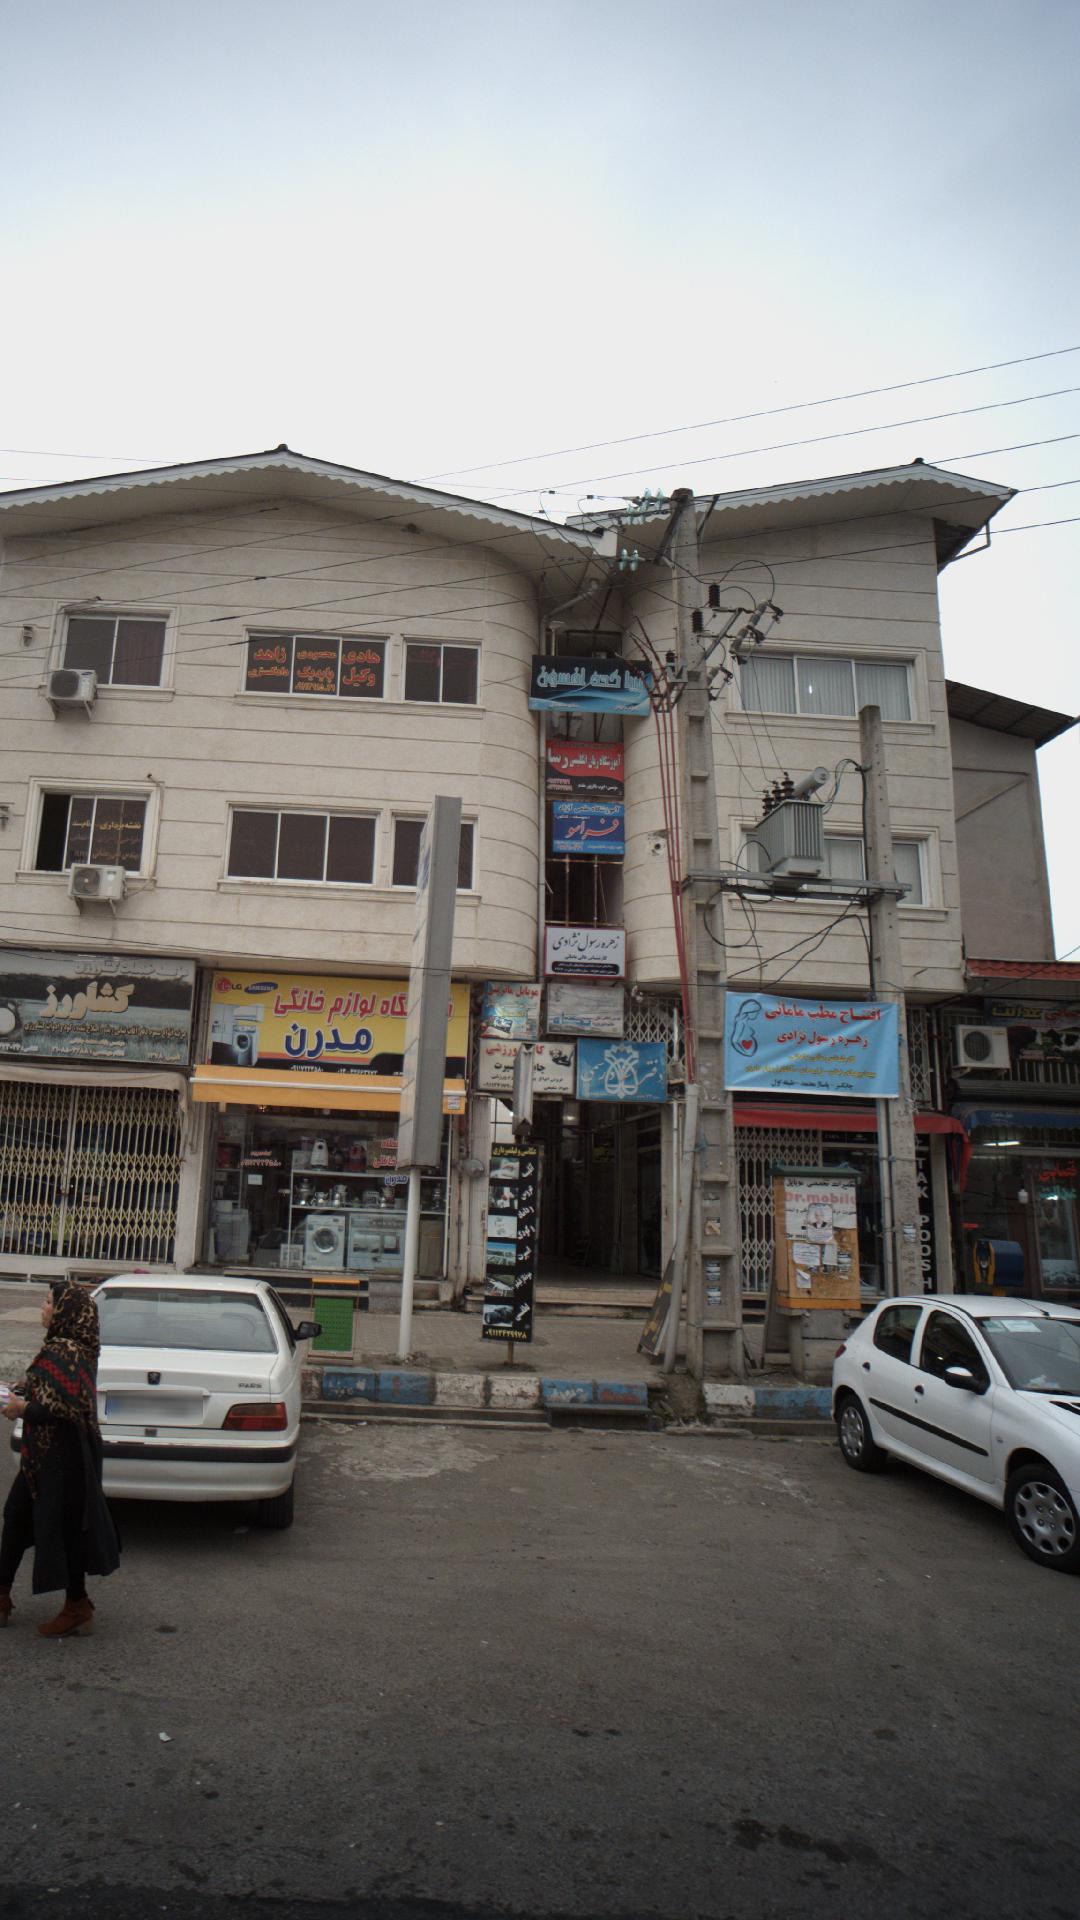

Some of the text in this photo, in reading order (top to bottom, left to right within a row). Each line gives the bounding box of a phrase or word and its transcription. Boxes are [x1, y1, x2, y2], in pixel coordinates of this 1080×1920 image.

[39, 982, 136, 1020] کشاورز
[231, 983, 243, 991] LG
[273, 985, 325, 1018] خانگی
[327, 990, 377, 1026] لوازم
[839, 1007, 881, 1024] افتتاح
[285, 1022, 373, 1059] مدرن
[485, 1043, 519, 1057] ورزشی
